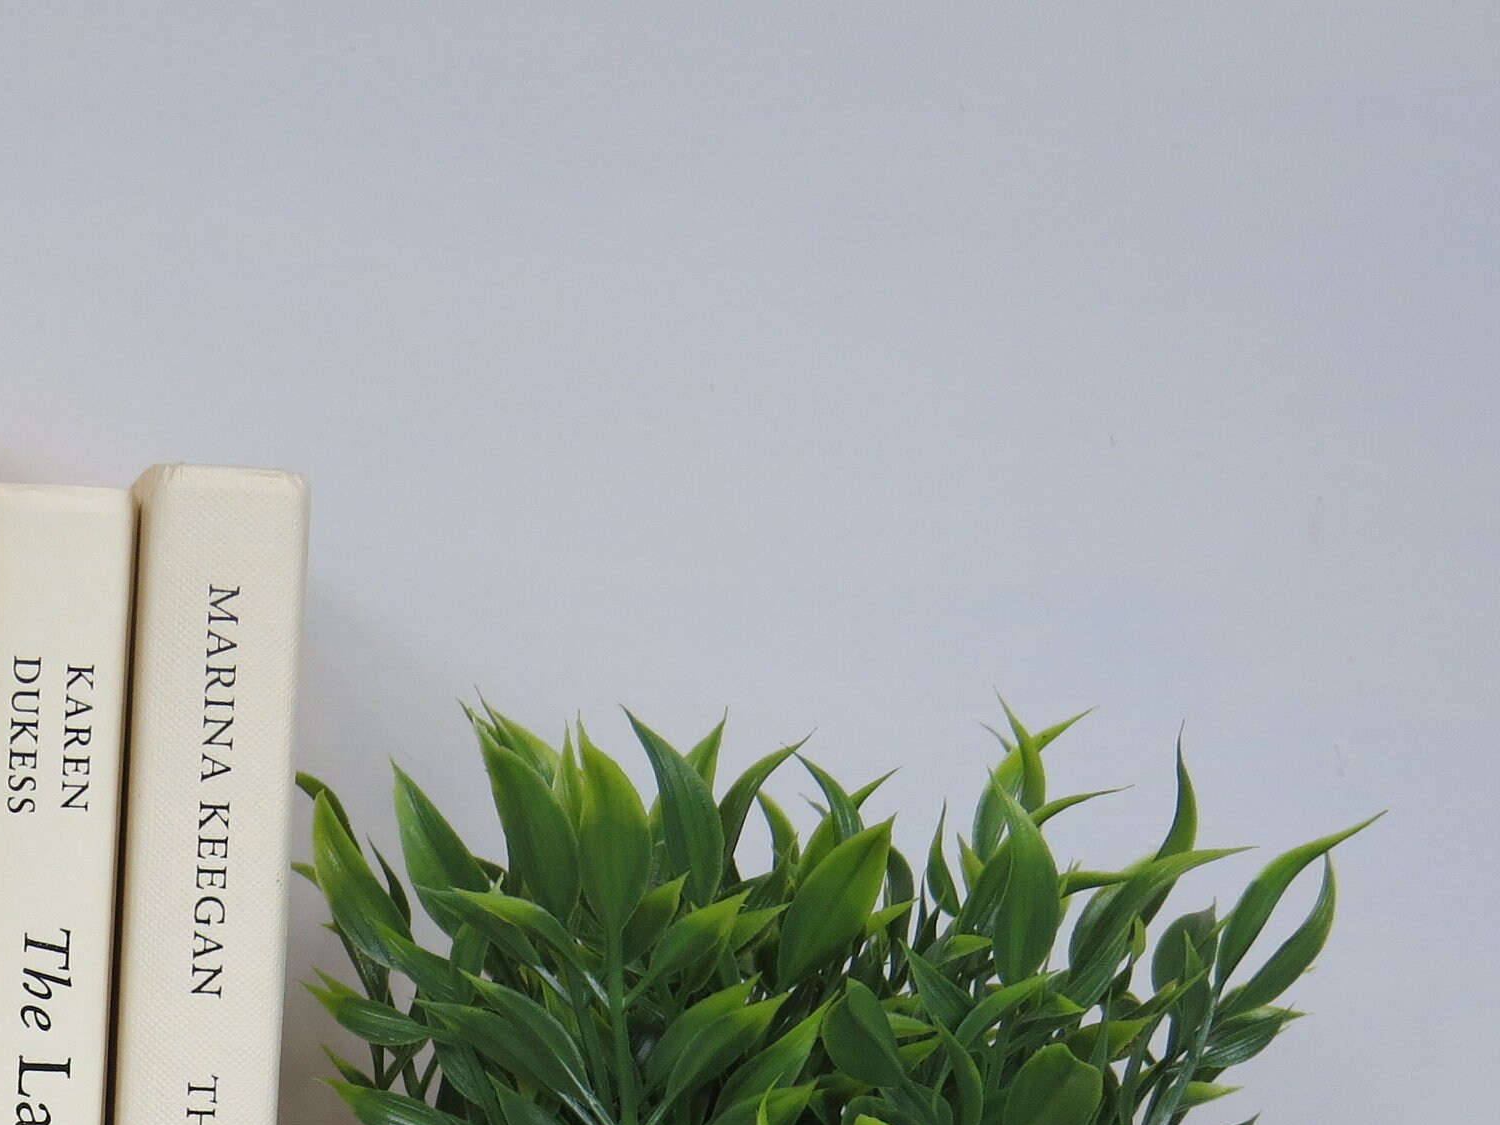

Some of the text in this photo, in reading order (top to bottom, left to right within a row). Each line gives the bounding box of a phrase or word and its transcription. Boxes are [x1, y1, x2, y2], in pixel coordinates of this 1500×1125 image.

[6, 655, 42, 814] DUKESS
[60, 664, 95, 812] KAREN
[190, 584, 241, 999] MARINA KEEGAN
[20, 928, 72, 1032] The
